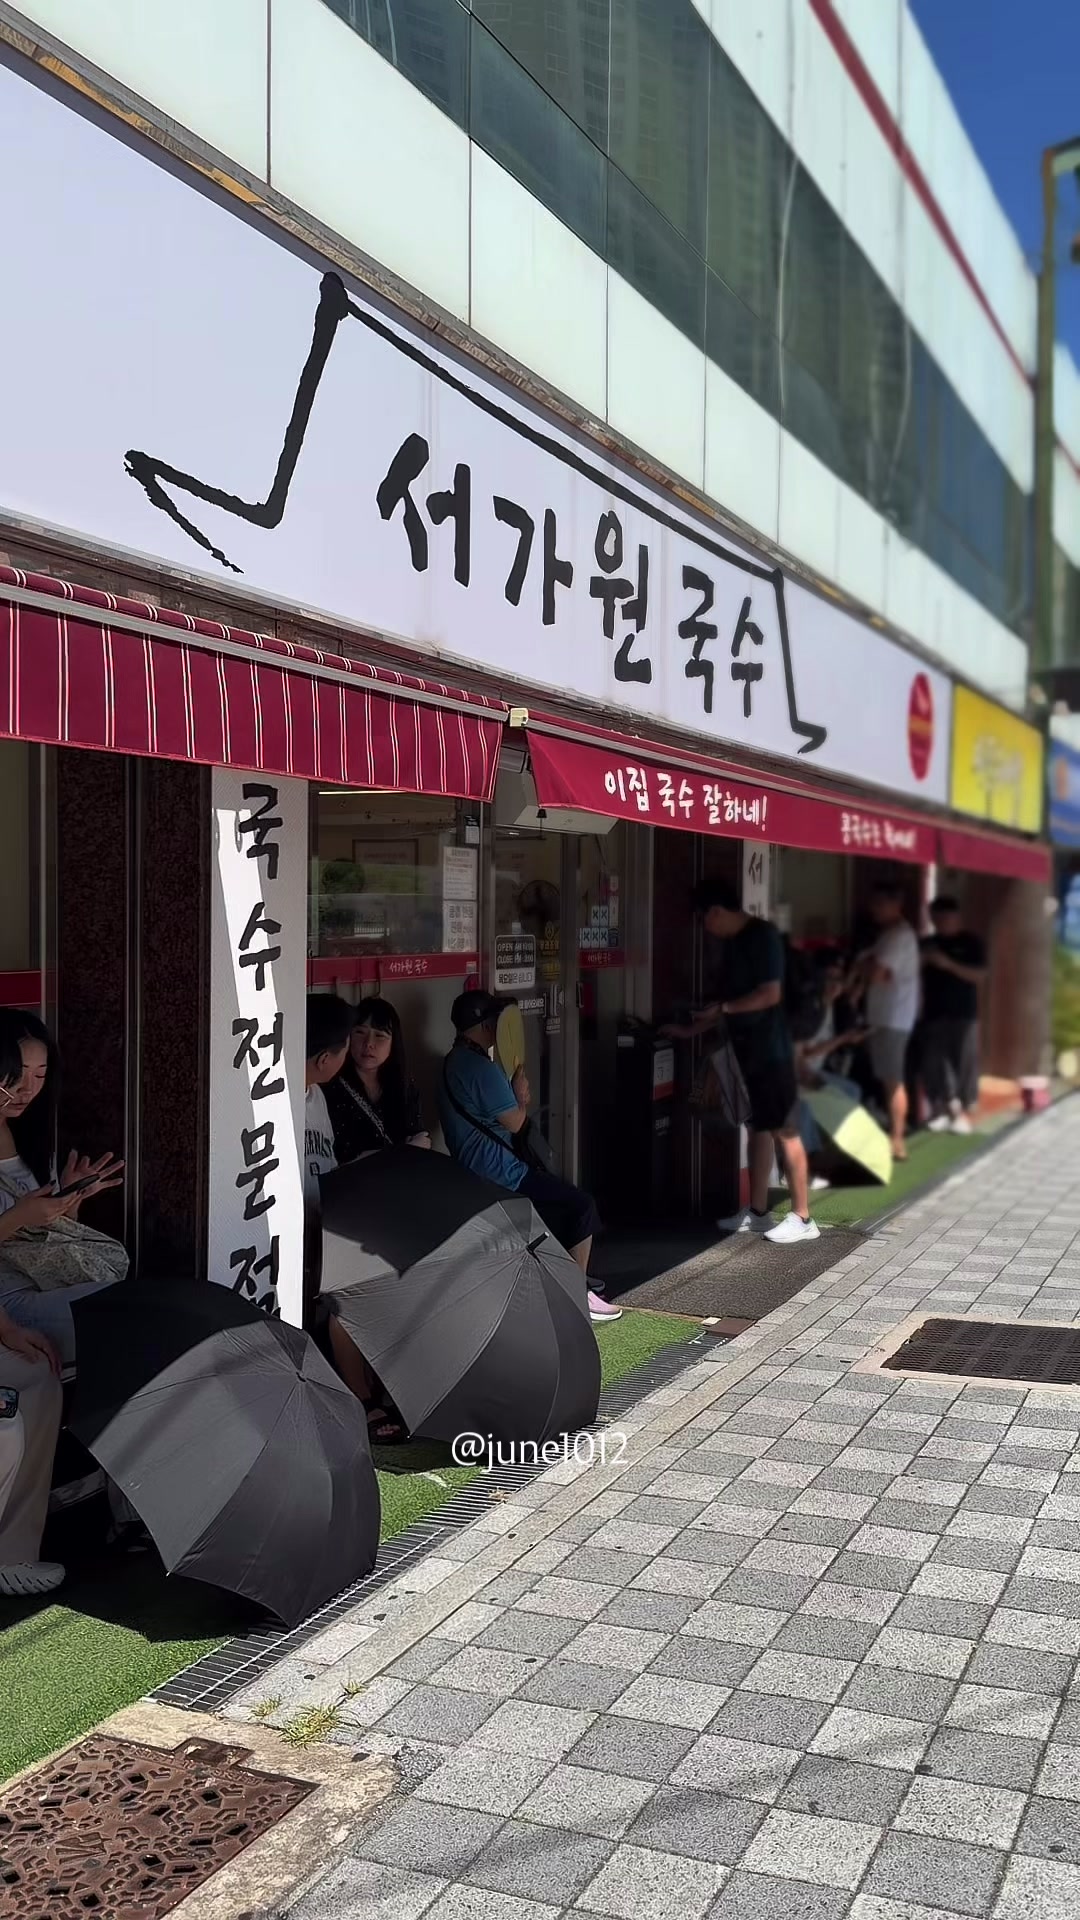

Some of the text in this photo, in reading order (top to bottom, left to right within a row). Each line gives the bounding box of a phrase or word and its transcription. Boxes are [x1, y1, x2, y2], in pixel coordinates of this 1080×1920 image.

[604, 766, 768, 832] 이집 국수 잘하네!
[497, 943, 513, 952] OPEN
